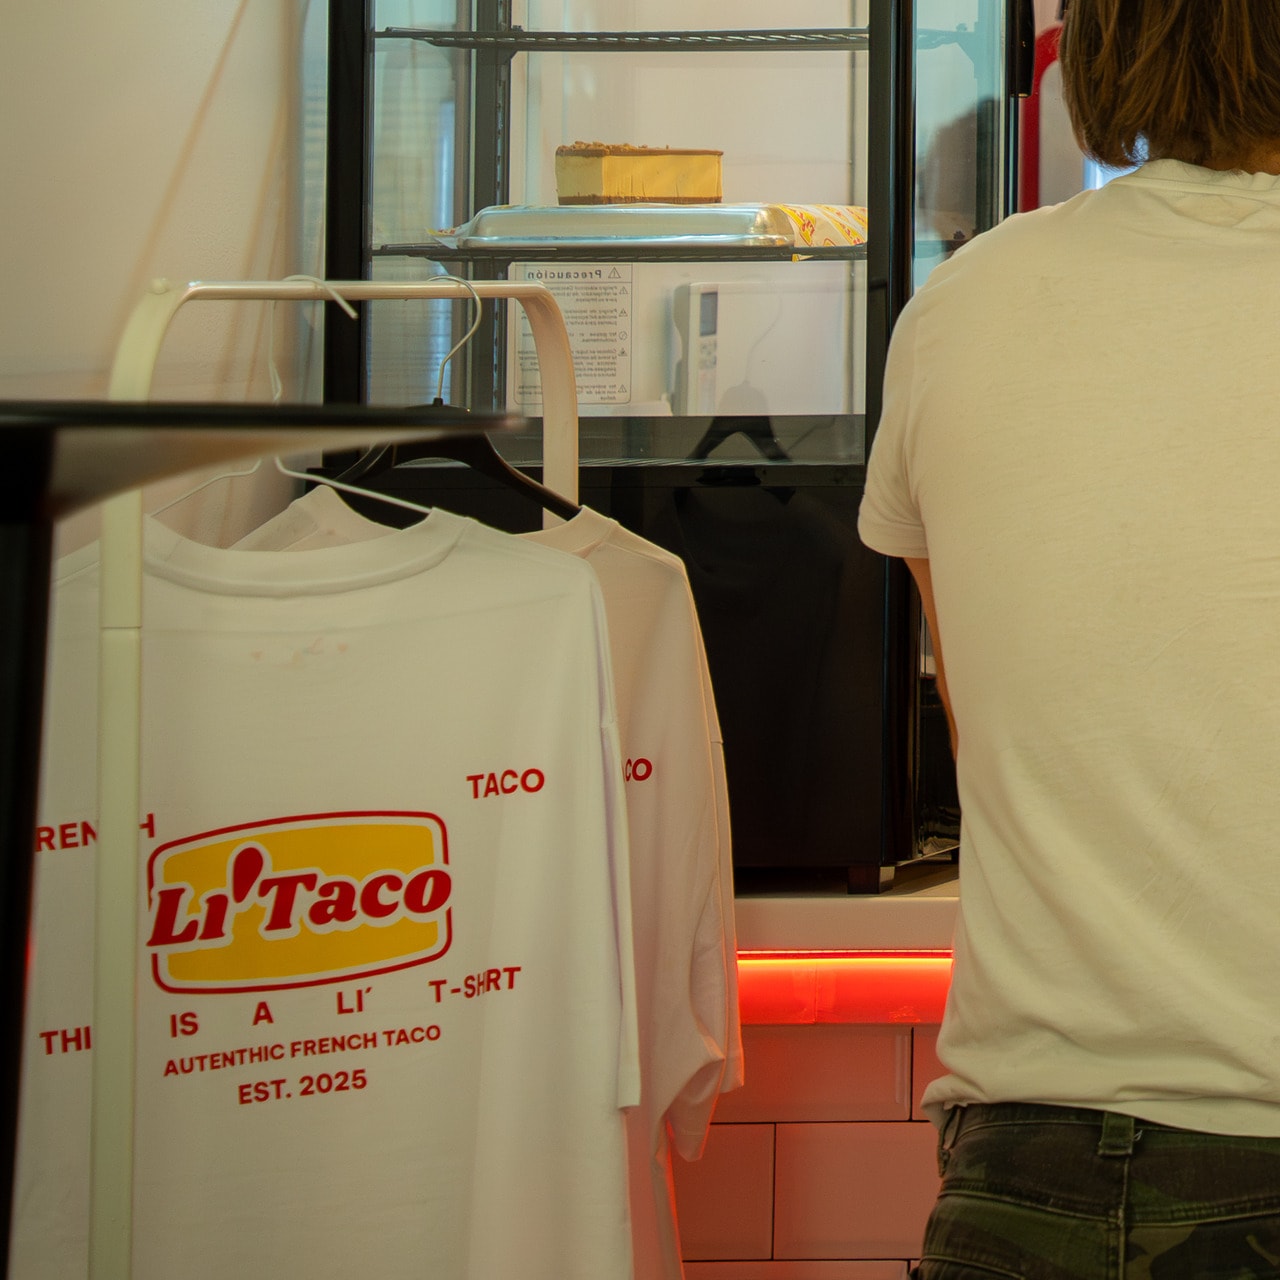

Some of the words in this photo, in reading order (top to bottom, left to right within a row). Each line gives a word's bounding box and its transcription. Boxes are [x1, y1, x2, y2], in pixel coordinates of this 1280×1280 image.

[466, 769, 545, 799] TACO
[146, 846, 452, 947] Li'Taco
[39, 1026, 92, 1055] THI
[170, 1012, 199, 1037] IS
[252, 1002, 274, 1026] A
[163, 1043, 285, 1077] AUTENTHIC
[291, 1031, 377, 1058] FRENCH
[383, 1024, 441, 1046] TACO
[238, 1079, 292, 1104] EST.
[300, 1069, 367, 1096] 2025
